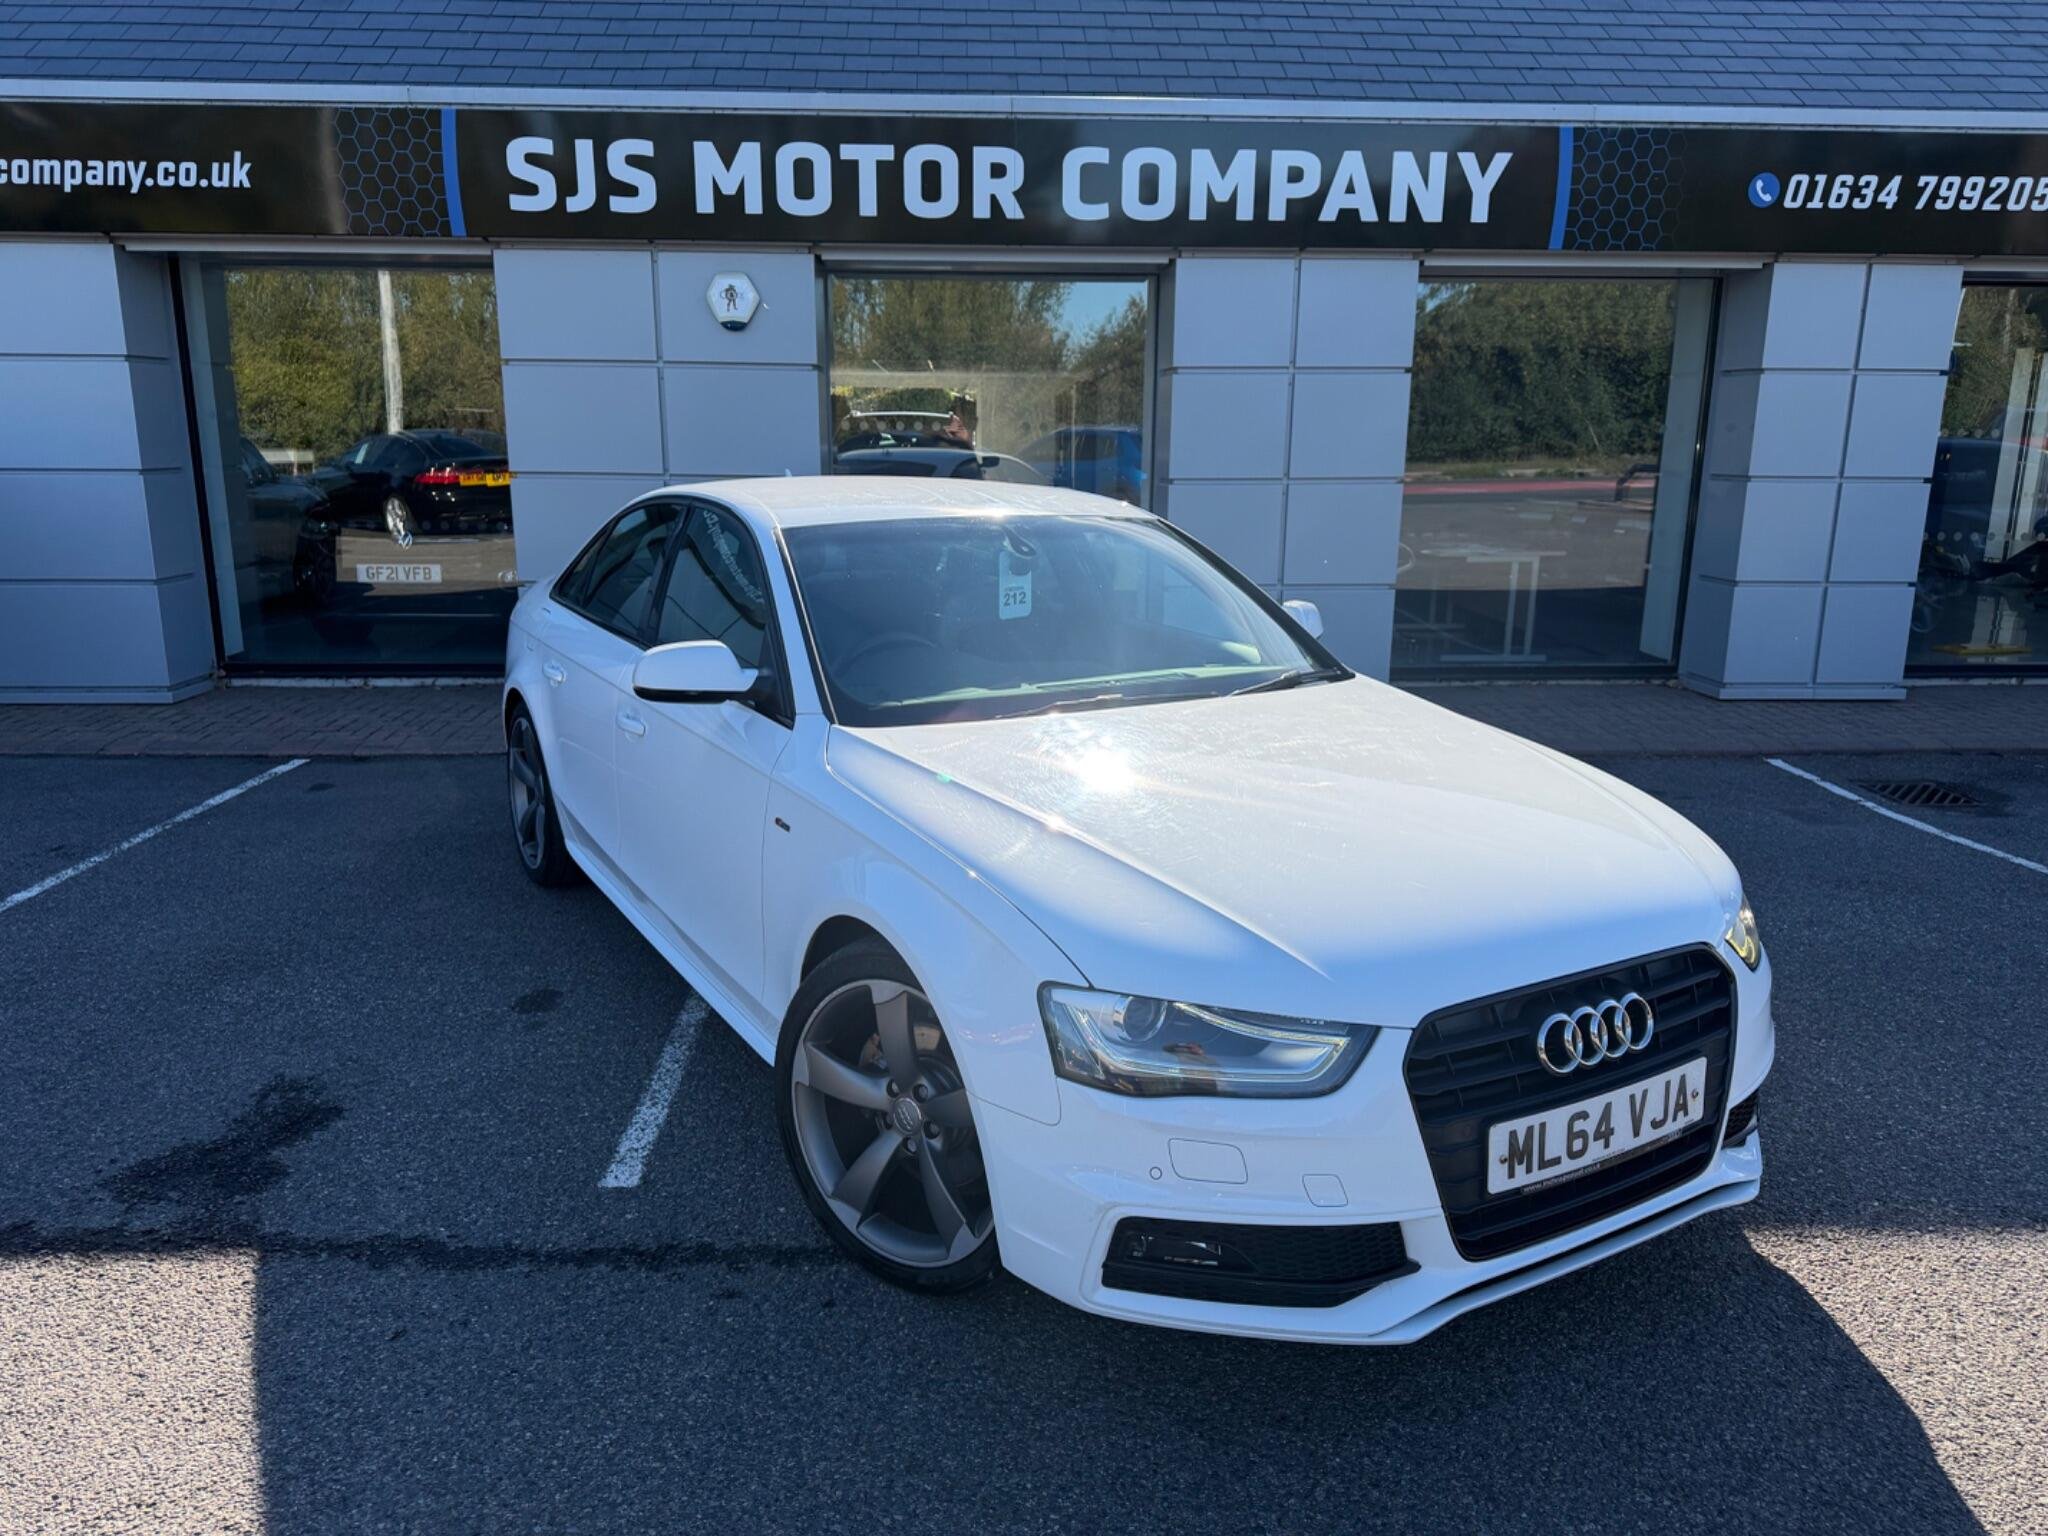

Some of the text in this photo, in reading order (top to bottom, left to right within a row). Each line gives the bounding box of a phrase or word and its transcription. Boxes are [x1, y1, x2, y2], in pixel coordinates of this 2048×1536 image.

[505, 136, 1513, 224] SJS MOTOR COMPANY
[1783, 173, 2048, 212] 01634 799205
[1003, 591, 1027, 606] 212
[1507, 1102, 1615, 1180] ML64
[1629, 1074, 1689, 1139] VJA
